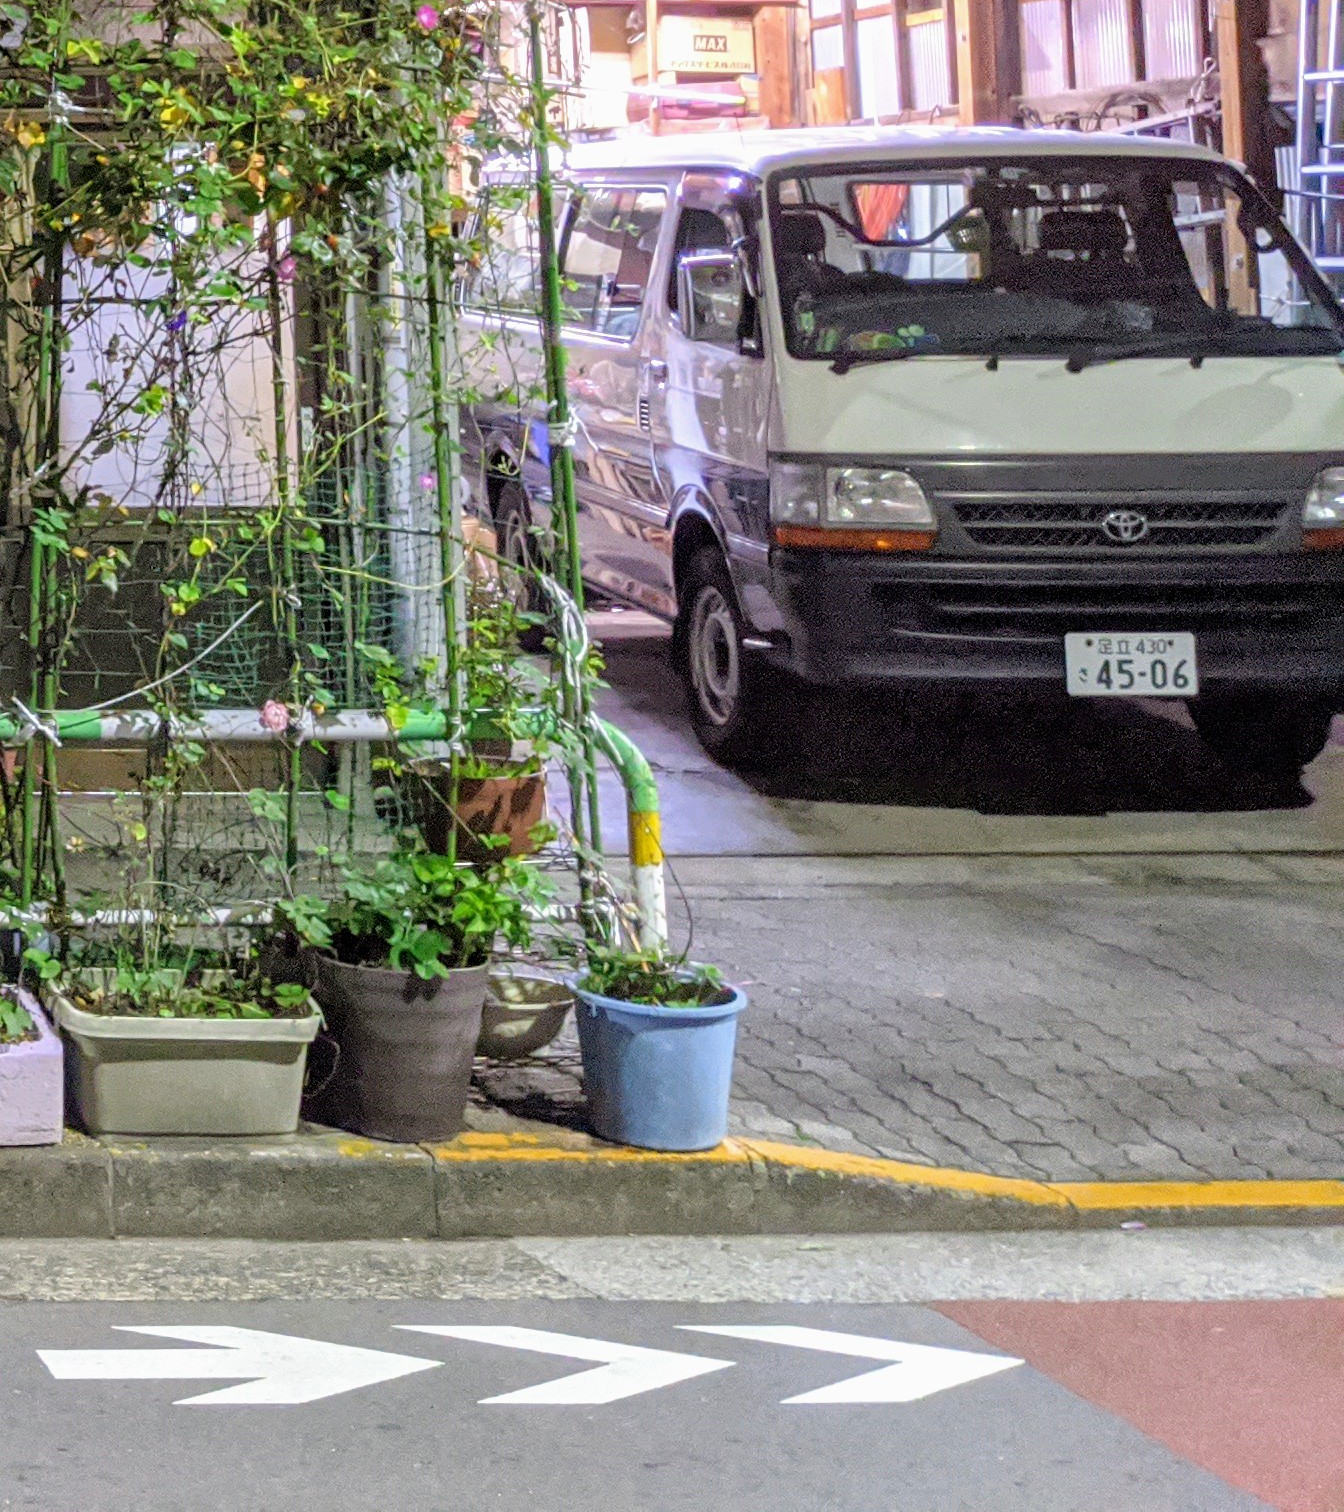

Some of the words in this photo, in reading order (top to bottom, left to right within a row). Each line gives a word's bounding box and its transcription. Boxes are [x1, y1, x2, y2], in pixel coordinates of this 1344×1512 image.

[694, 36, 726, 52] MAX
[1136, 639, 1167, 655] 430
[1096, 659, 1189, 690] 45-06
